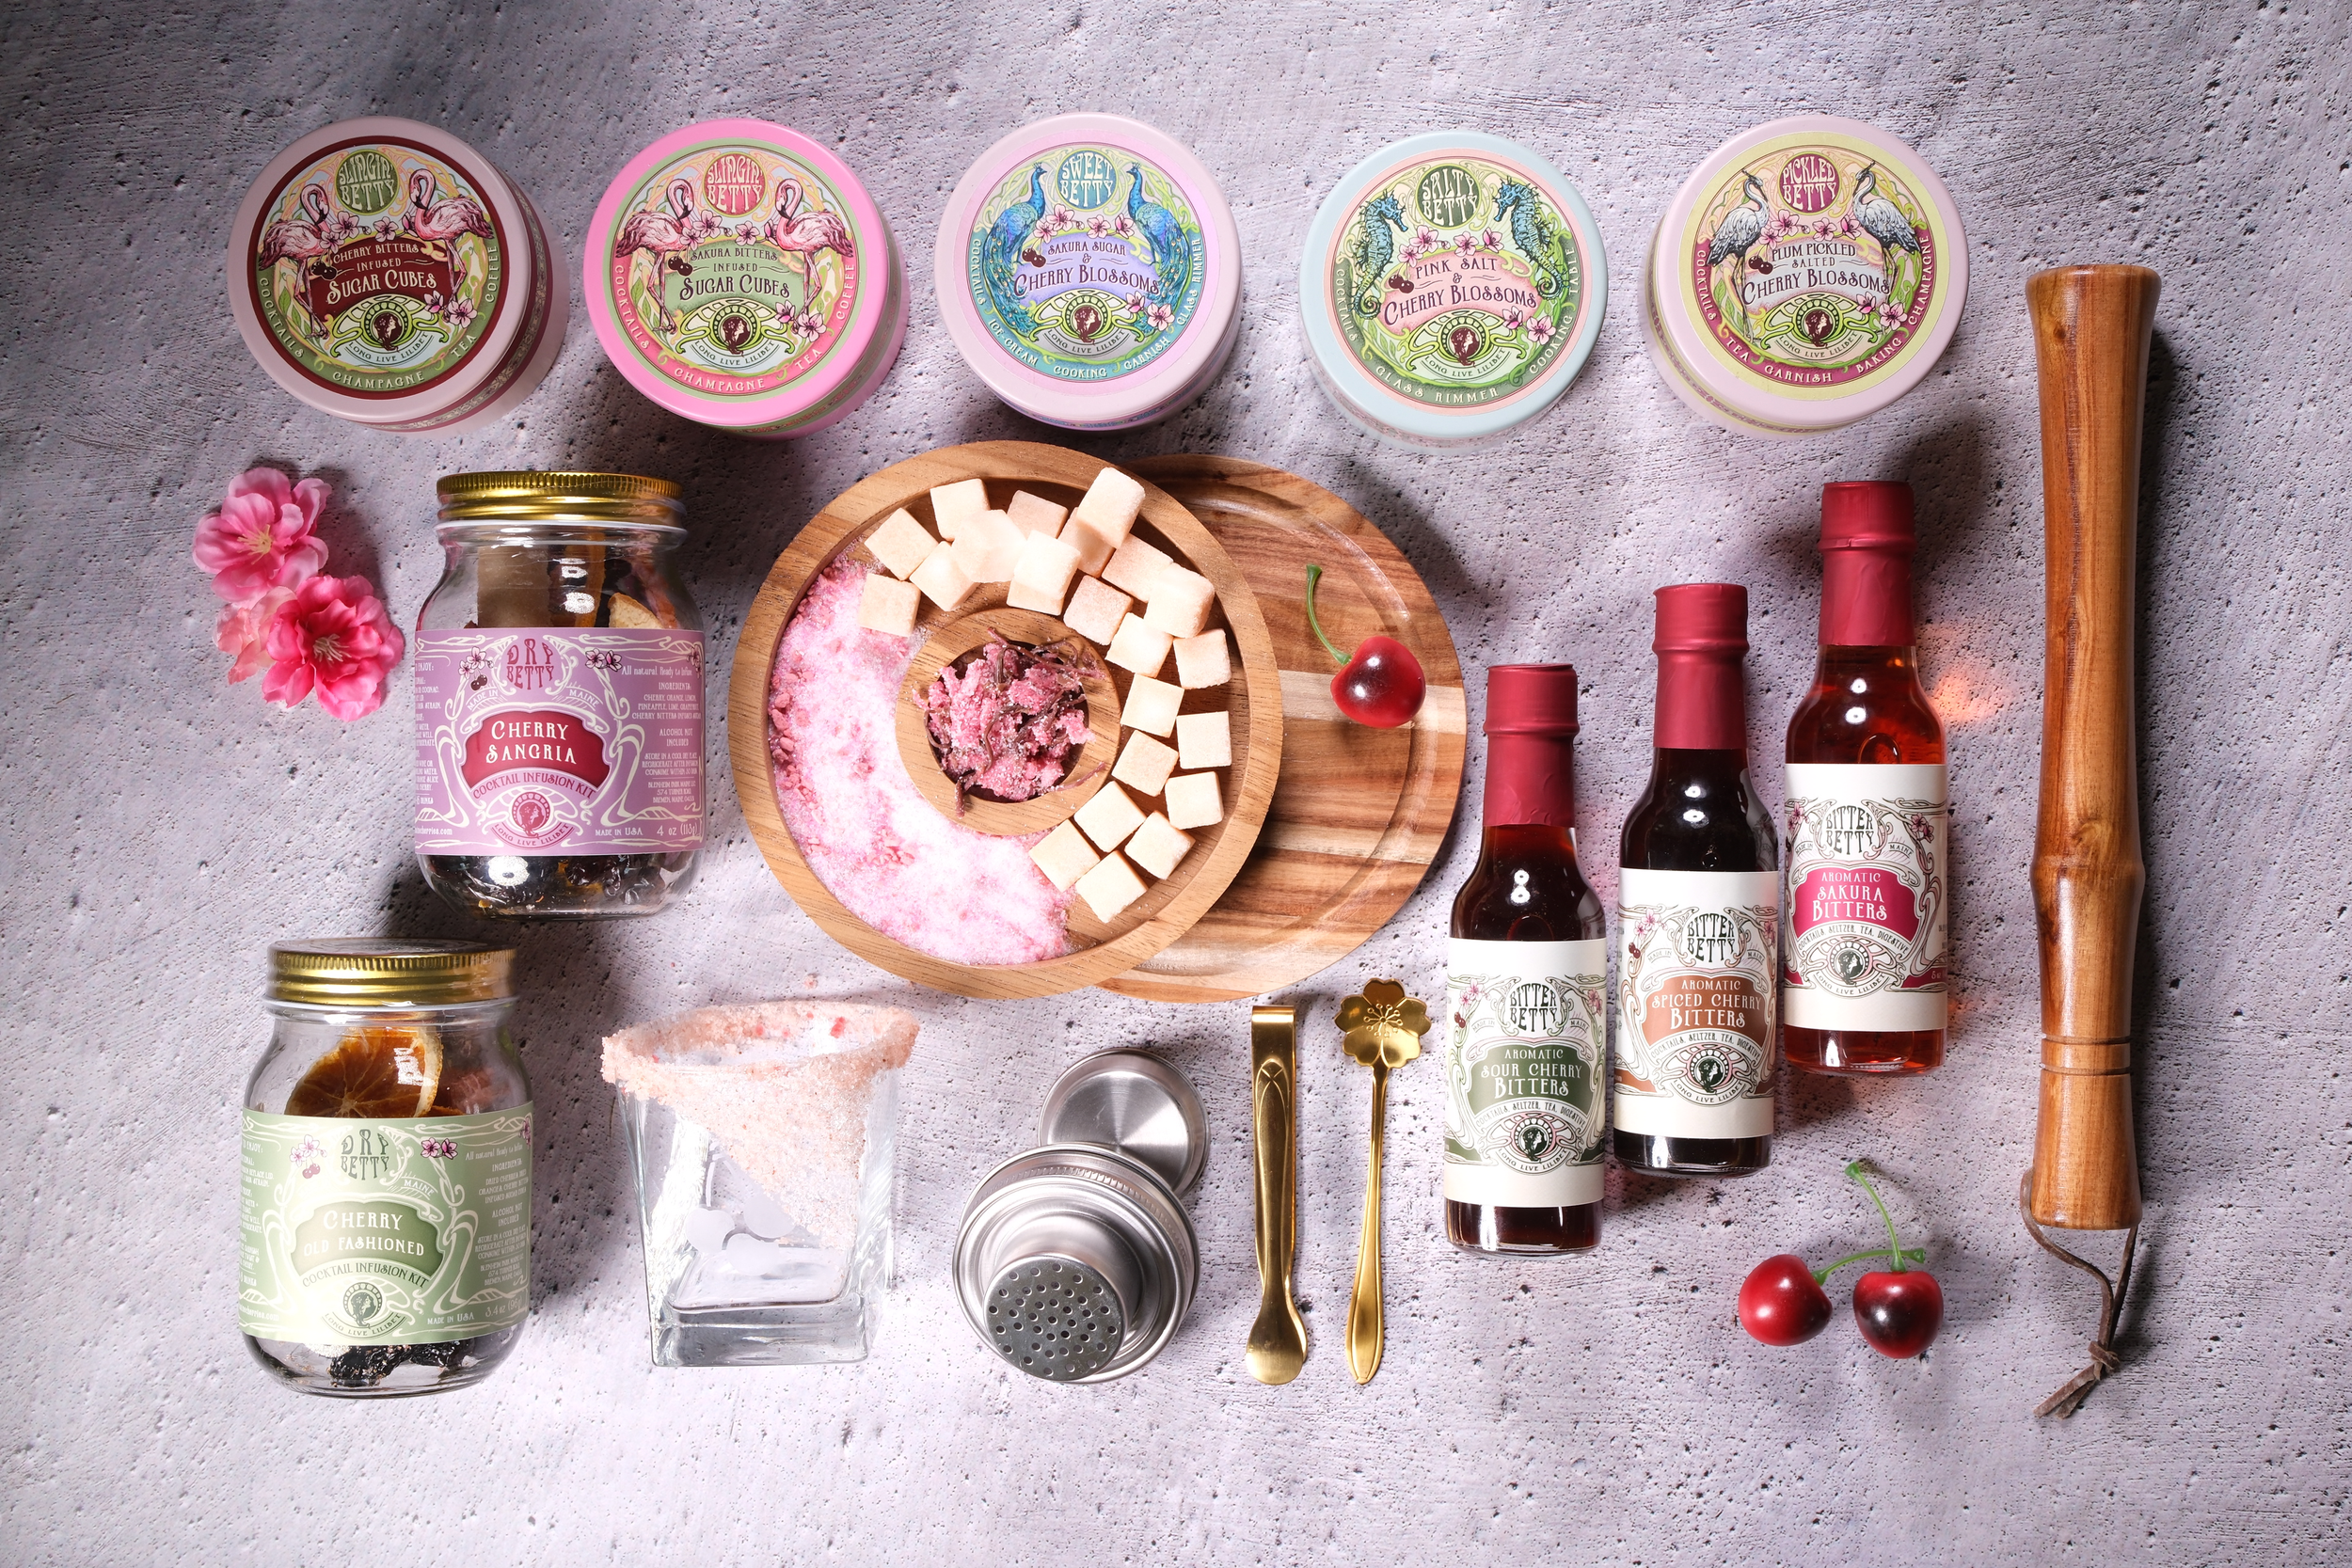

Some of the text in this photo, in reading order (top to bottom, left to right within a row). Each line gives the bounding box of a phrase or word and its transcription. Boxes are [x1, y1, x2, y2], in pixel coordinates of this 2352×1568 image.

[339, 152, 394, 182] SLINGIN'
[707, 156, 763, 183] SLINGIN'
[1061, 152, 1112, 181] SWEET
[1783, 156, 1836, 184] PICKLED
[1061, 181, 1113, 207] BETTY
[1422, 168, 1477, 198] SALTY
[341, 180, 394, 211] BETTY
[708, 184, 762, 213] BETTY
[1784, 182, 1836, 211] BETTY
[1422, 195, 1479, 226] BETTY
[333, 243, 420, 264] CHERRY BITTERS
[691, 248, 778, 261] SAKURA BITTERS
[1047, 243, 1126, 256] SAKURA SUGAR
[1083, 254, 1092, 263] &
[1772, 243, 1856, 261] PLUM PICKLED
[357, 259, 402, 273] INFUSED
[485, 245, 497, 303] COFFEE
[713, 262, 758, 273] INFUSED
[972, 238, 986, 305] COCKTAILS
[1416, 257, 1498, 279] PINK SALT
[1791, 258, 1836, 268] SALTED
[326, 270, 437, 305] SUGAR CUBES
[680, 275, 790, 300] SUGAR CUBES
[1014, 264, 1160, 297] CHERRY BLOSSOMS
[1177, 238, 1201, 325] GLASS RIMMER
[1453, 273, 1462, 283] &
[1697, 250, 1715, 321] COCKTAILS
[1741, 270, 1890, 306] CHERRY BLOSSOMS
[1908, 235, 1932, 325] CHAMPAGNE
[835, 264, 854, 320] COFFEE
[615, 265, 649, 350] COCKTAILS
[1336, 268, 1358, 342] COCKTAILS
[1384, 285, 1536, 325] CHERRY BLOSSOMS
[1529, 246, 1581, 374] COOKING TABLE
[260, 277, 305, 358] COCKTAILS
[349, 342, 372, 360] LONG
[402, 332, 429, 360] LILIBET
[451, 334, 477, 358] TEA
[1047, 329, 1068, 350] LONG
[1096, 329, 1125, 351] LILIBET
[1725, 336, 1750, 362] TEA
[1779, 336, 1801, 355] LONG
[1830, 332, 1856, 355] LILIBET
[694, 340, 774, 366] LONG LIVE LILIBET
[795, 347, 822, 370] TEA
[1123, 338, 1170, 370] GARNISH
[1424, 356, 1448, 375] LONG
[1477, 348, 1506, 374] LILIBET
[1855, 338, 1902, 373] BAKING
[332, 372, 424, 388] CHAMPAGNE
[675, 367, 765, 391] CHAMPAGNE
[1054, 365, 1107, 378] COOKING
[1764, 365, 1834, 383] GARNISH
[1375, 366, 1499, 404] GLASS RIMMER
[507, 638, 553, 665] DRY
[506, 665, 553, 689] BETTY
[622, 665, 631, 675] All
[634, 666, 658, 675] natural
[468, 689, 498, 710] MADE IN
[569, 691, 599, 707] MAINE
[491, 721, 569, 740] CHERRY
[485, 744, 577, 764] SANGRIA
[472, 772, 596, 800] COCKTAIL INFUSION KIT
[1826, 805, 1873, 830] BITTER
[495, 824, 513, 842] LONG
[540, 824, 568, 845] LILIBET
[625, 827, 644, 835] USA
[657, 827, 664, 836] 4
[1826, 831, 1874, 855] BETTY
[1889, 844, 1913, 856] MAINE
[1821, 872, 1881, 883] AROMATIC
[1818, 885, 1884, 902] SAKURA
[1813, 900, 1887, 921] BITTERS
[1687, 913, 1735, 937] BITTER
[1687, 938, 1736, 962] BETTY
[1878, 931, 1909, 954] DIGESTIVE
[1681, 980, 1740, 990] AROMATIC
[1815, 972, 1833, 990] LONG
[1857, 973, 1885, 993] LILIBET
[1509, 984, 1557, 1006] BITTER
[1652, 993, 1762, 1010] SPICED CHERRY
[1509, 1007, 1557, 1032] BETTY
[1671, 1009, 1745, 1029] BITTERS
[1504, 1049, 1564, 1059] AROMATIC
[1481, 1063, 1582, 1078] SOUR CHERRY
[1495, 1079, 1569, 1098] BITTERS
[1674, 1081, 1692, 1098] LONG
[1719, 1081, 1743, 1102] LILIBET
[1560, 1106, 1586, 1128] DIGESTIVE
[342, 1129, 389, 1155] DRY
[342, 1156, 389, 1180] BETTY
[1498, 1148, 1517, 1165] LONG
[1543, 1148, 1567, 1170] LILIBET
[404, 1180, 435, 1196] MAINE
[324, 1211, 403, 1229] CHERRY
[303, 1237, 424, 1257] OLD FASHIONED
[303, 1262, 428, 1288] COCKTAIL INFUSION KIT
[325, 1314, 344, 1333] LONG
[372, 1314, 401, 1335] LILIBET
[456, 1313, 474, 1322] USA
